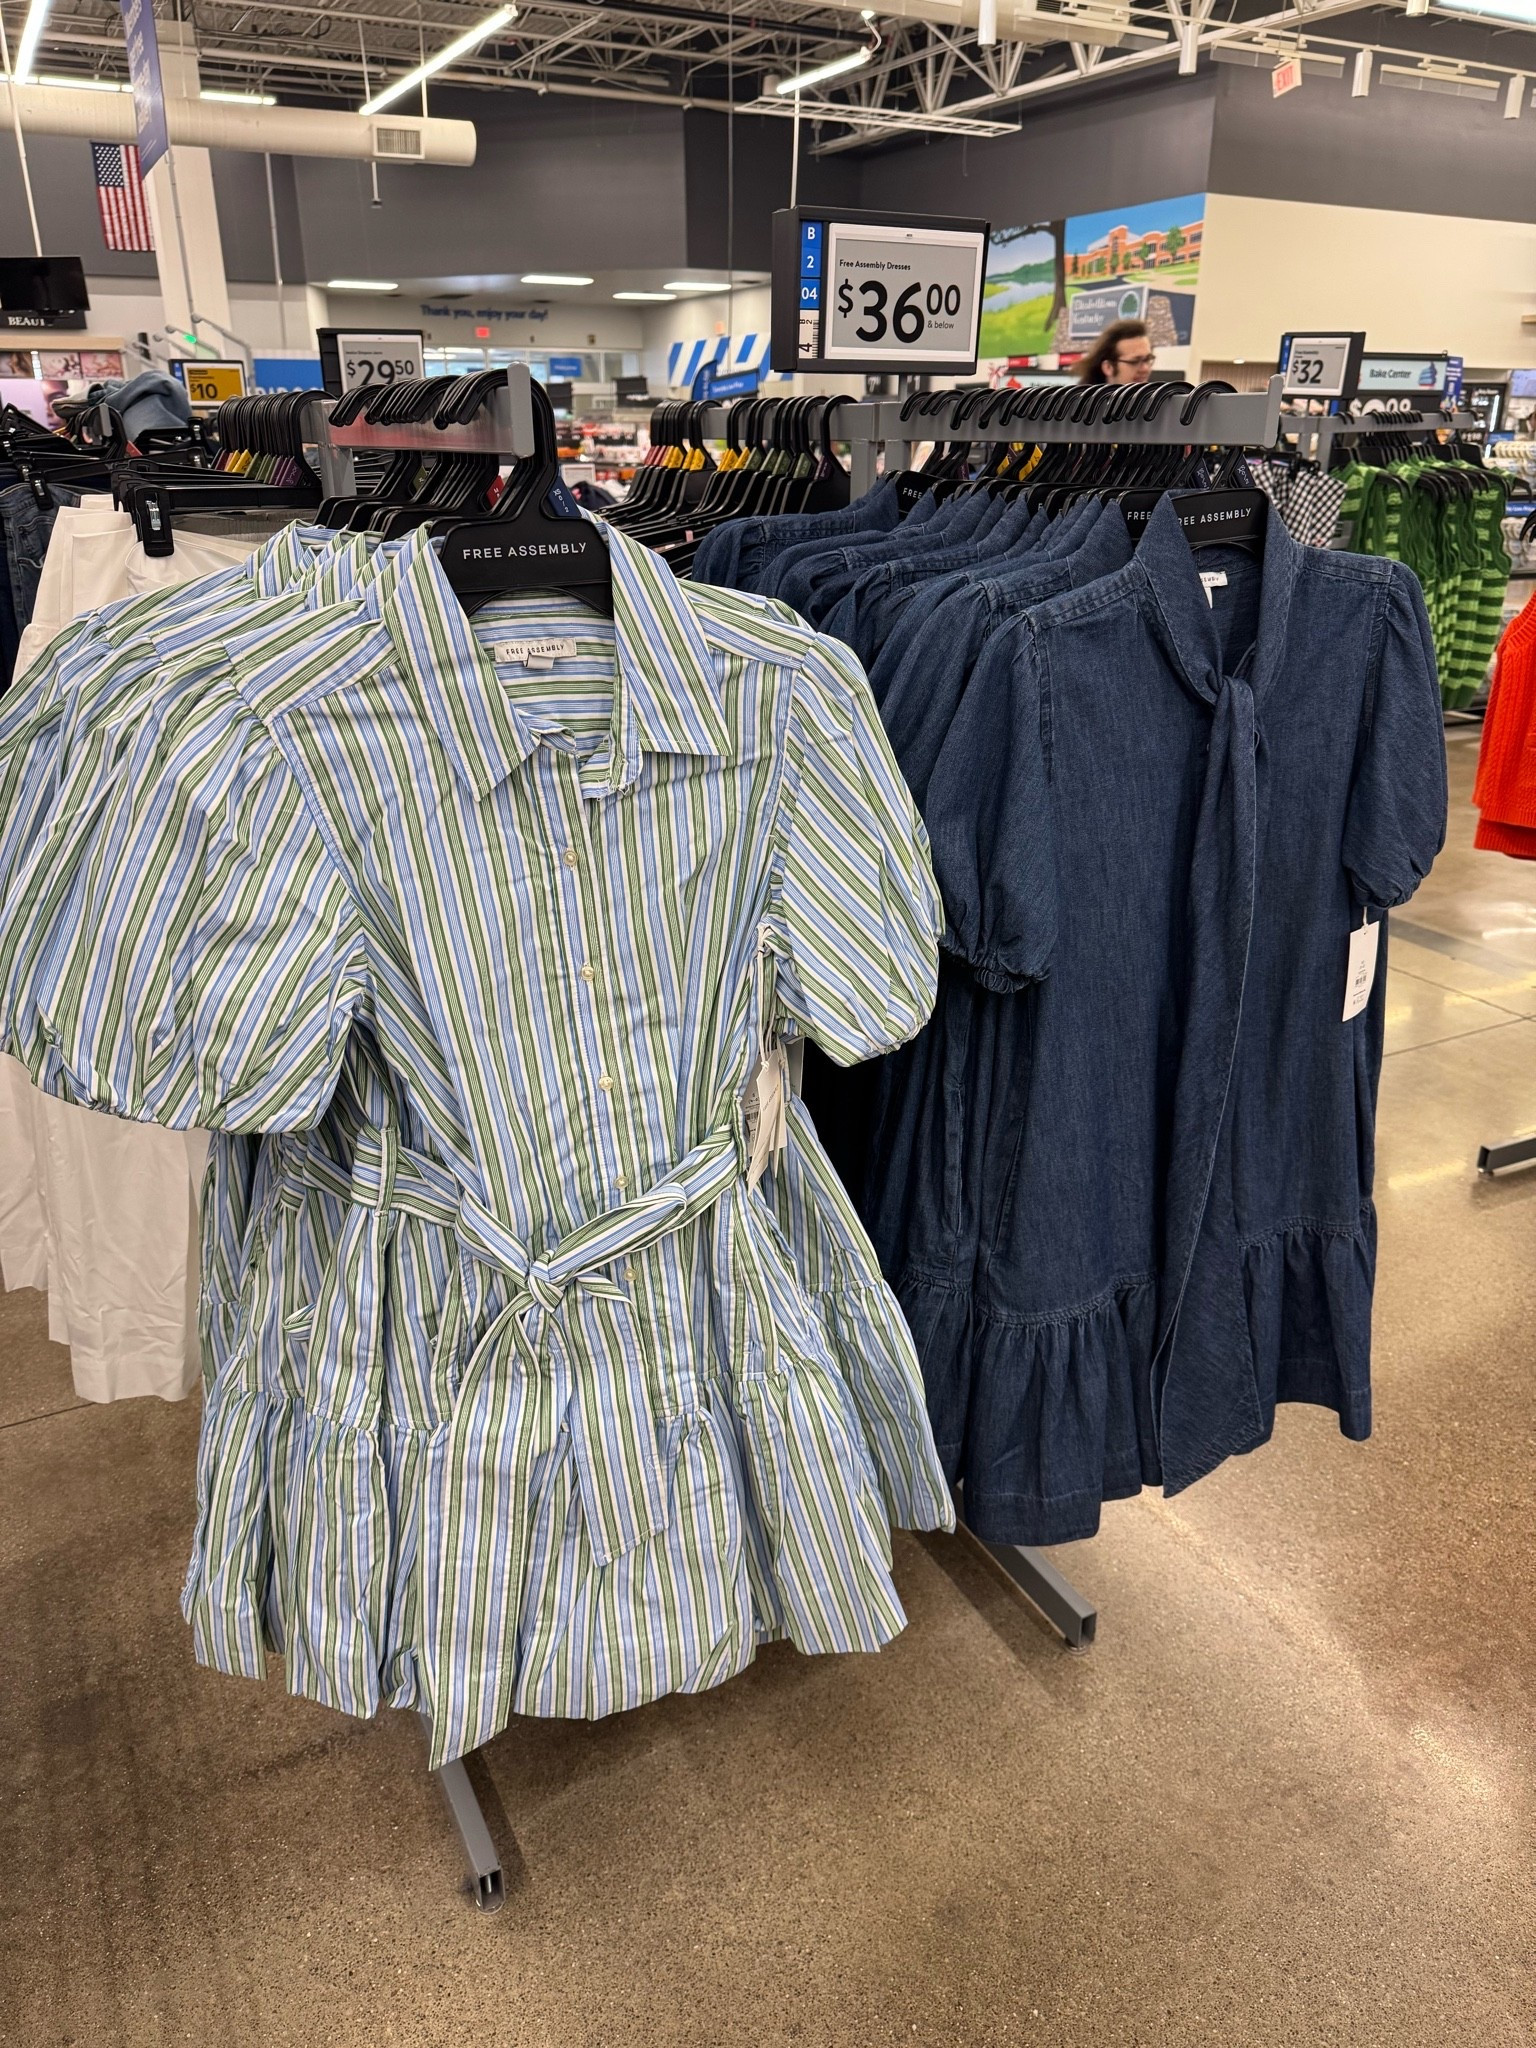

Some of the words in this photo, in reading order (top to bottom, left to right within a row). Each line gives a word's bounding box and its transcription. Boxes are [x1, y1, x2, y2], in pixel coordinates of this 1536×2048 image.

[1276, 65, 1294, 91] EXIT
[807, 227, 815, 240] B
[807, 255, 814, 268] 2
[839, 259, 854, 268] Free
[855, 260, 885, 271] Assembly
[887, 262, 911, 271] Dresses
[801, 287, 818, 300] 04
[927, 320, 933, 329] &
[934, 320, 954, 329] below
[1292, 359, 1324, 384] $32
[1369, 368, 1387, 378] Bake
[1388, 368, 1412, 379] Center
[190, 383, 218, 399] $10
[1127, 511, 1151, 521] FREE
[1178, 517, 1195, 527] REE
[1200, 508, 1252, 524] ASSEMBLY
[463, 547, 502, 560] FREE
[508, 542, 587, 557] ASSEMBLY
[506, 647, 524, 655] FREE
[527, 644, 564, 654] ASSEMBLY
